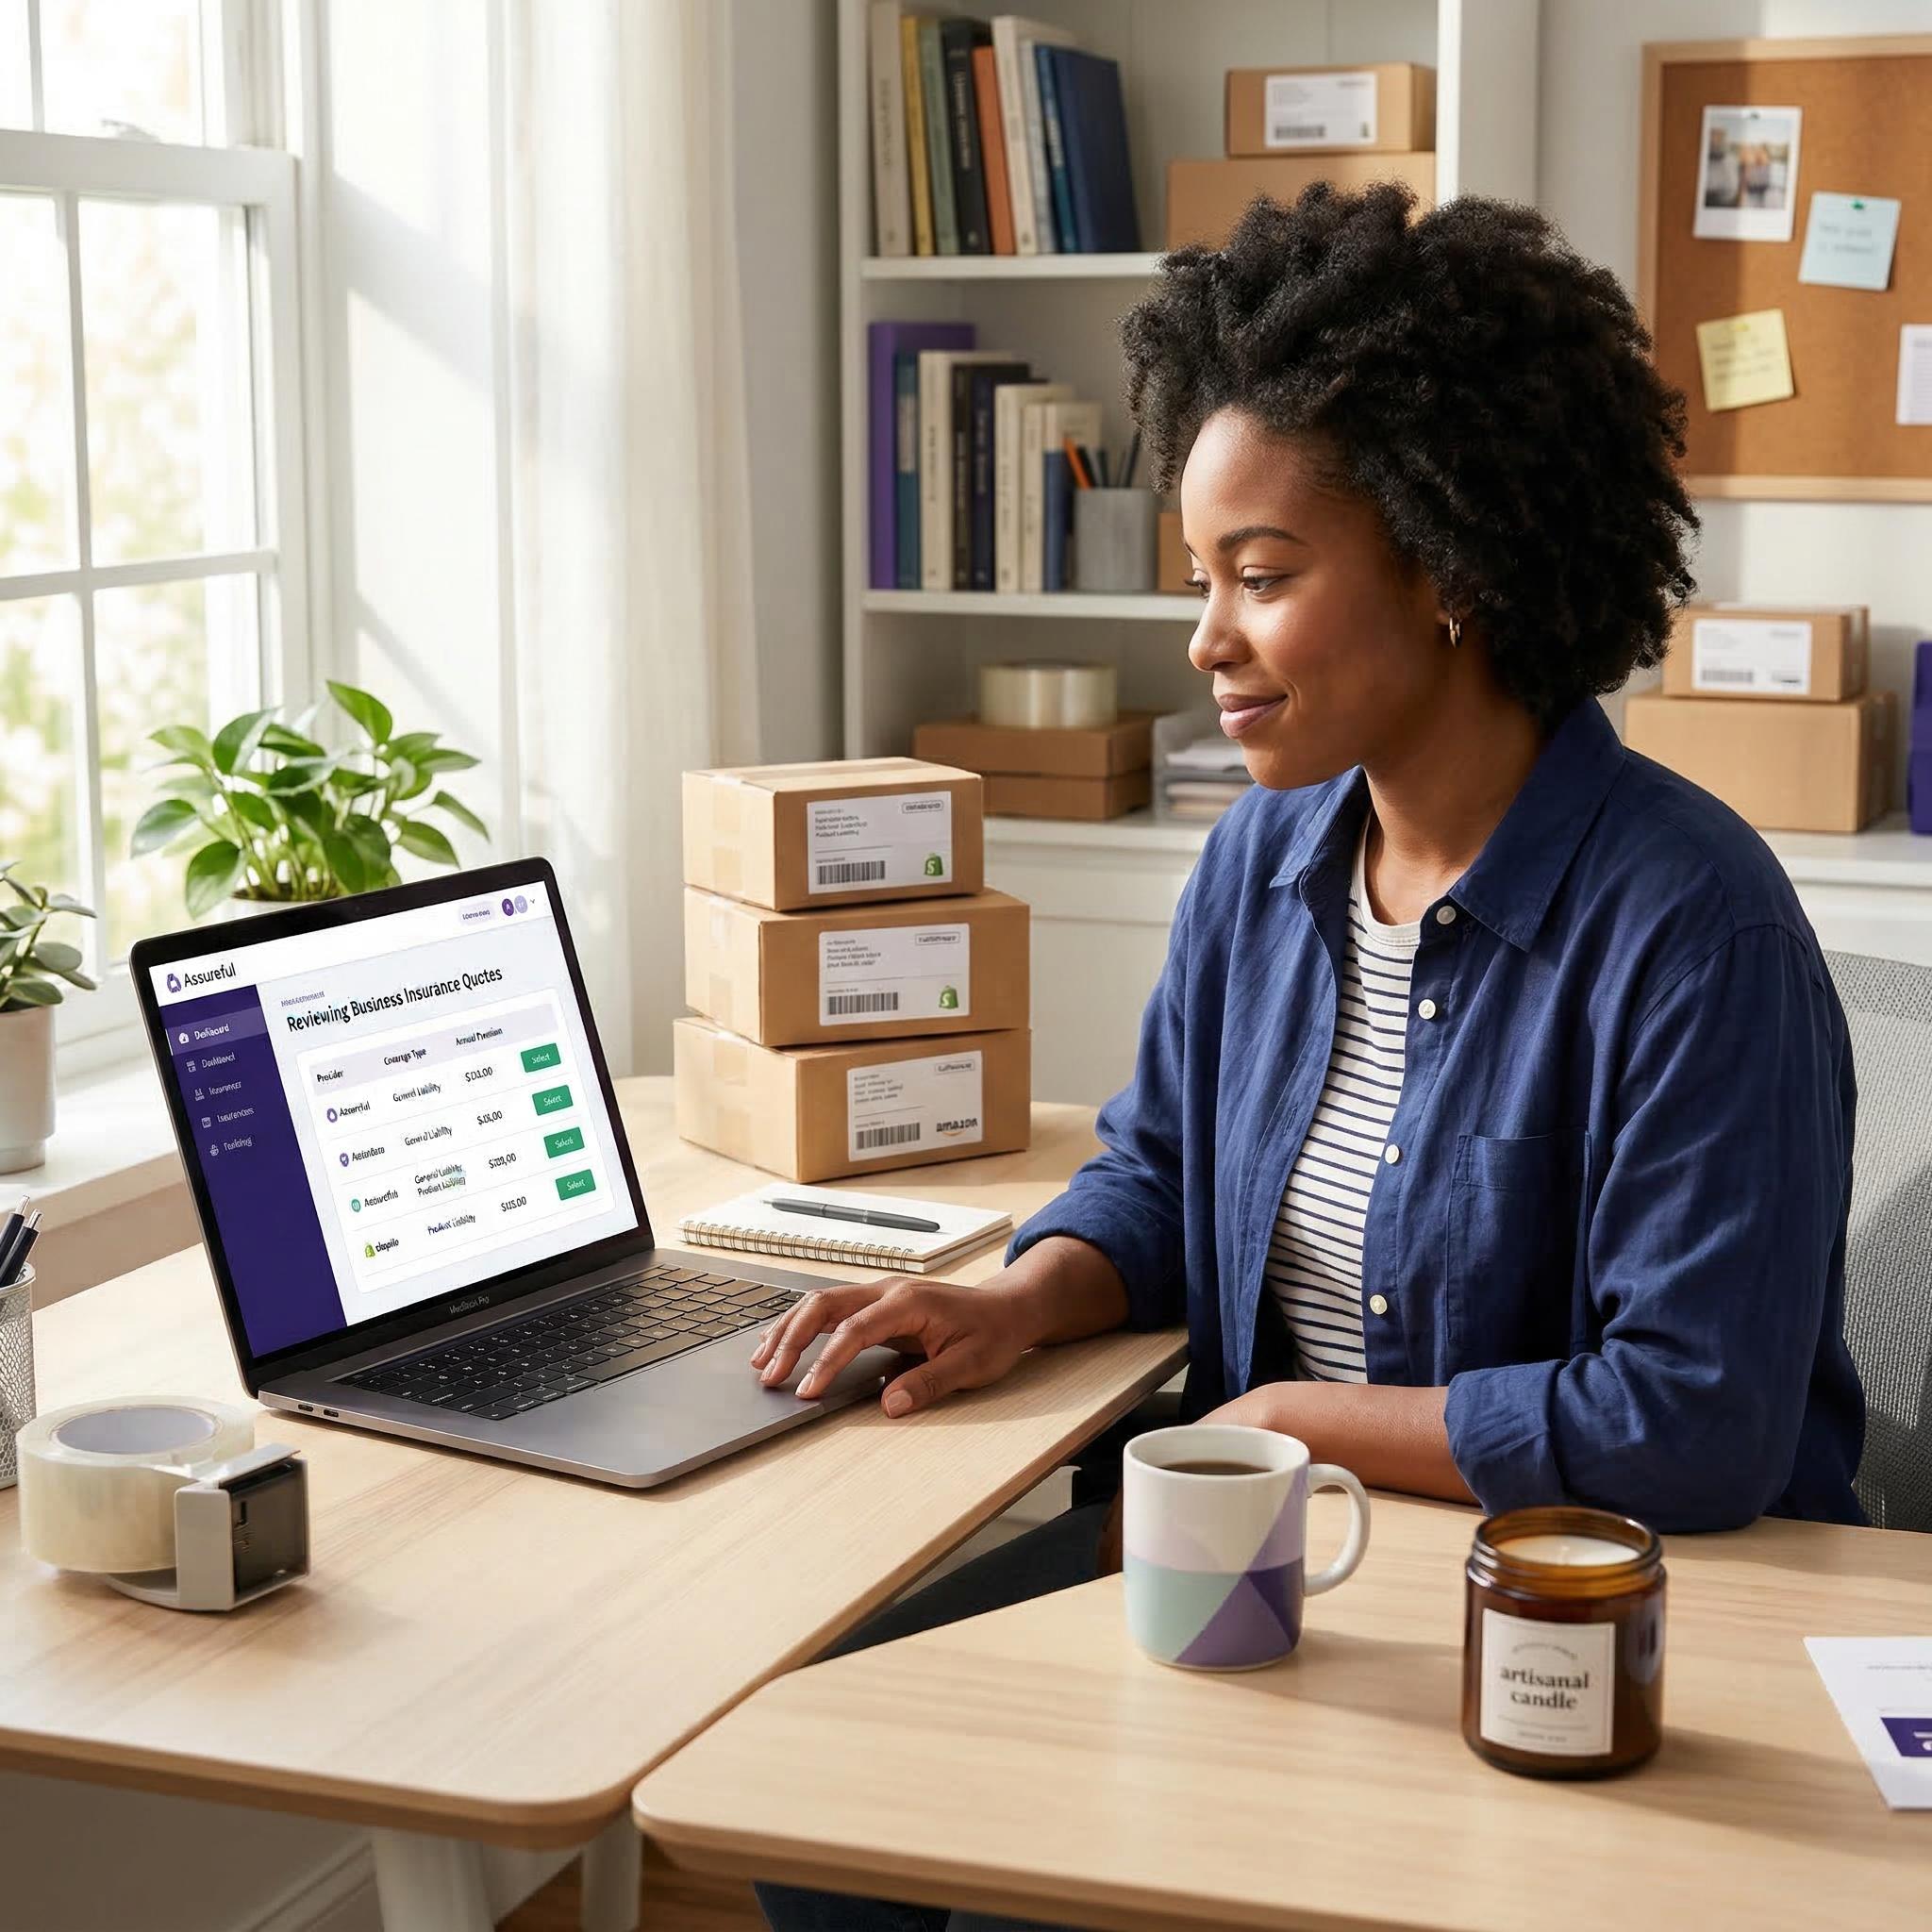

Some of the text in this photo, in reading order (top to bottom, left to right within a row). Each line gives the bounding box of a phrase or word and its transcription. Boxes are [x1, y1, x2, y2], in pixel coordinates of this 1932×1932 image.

[184, 962, 236, 988] Assureful
[350, 992, 404, 1017] Business
[404, 979, 460, 1004] Insurance
[1500, 1666, 1590, 1689] artisanal
[1510, 1690, 1578, 1709] candle
